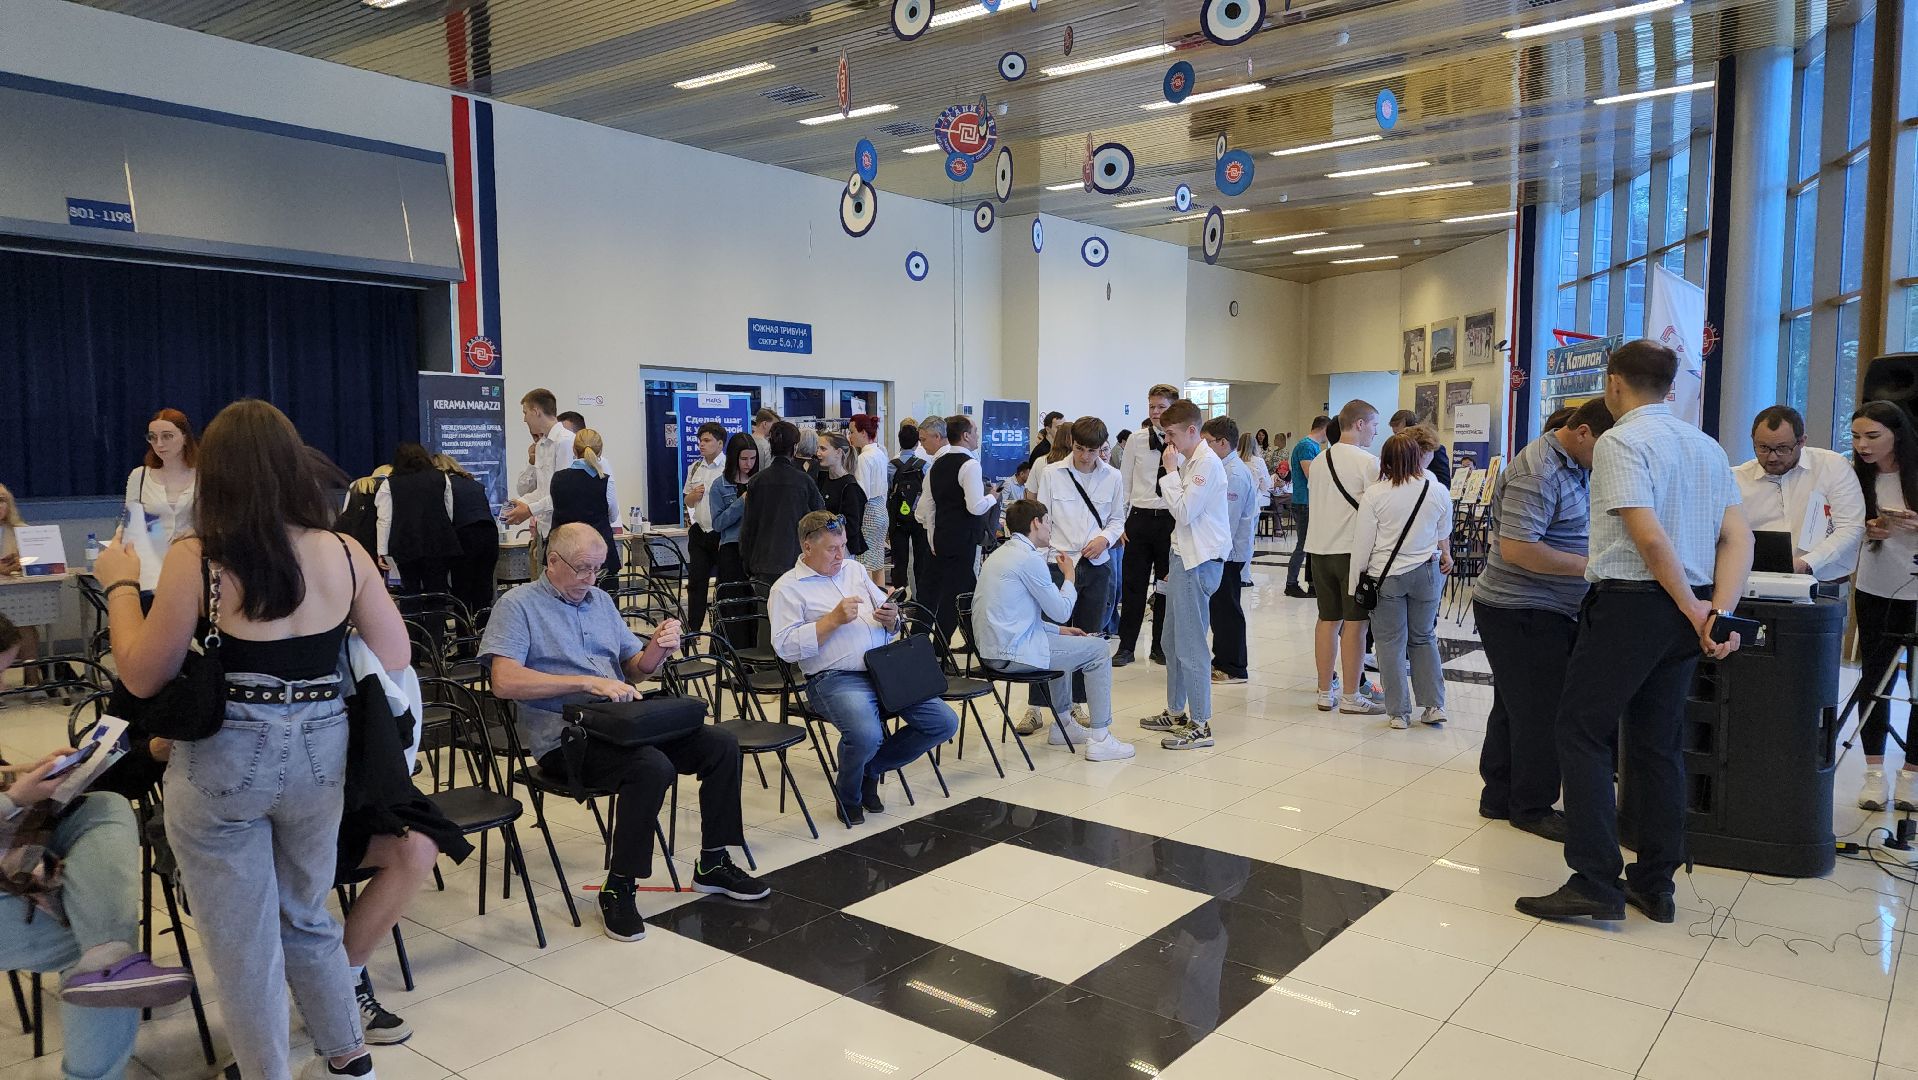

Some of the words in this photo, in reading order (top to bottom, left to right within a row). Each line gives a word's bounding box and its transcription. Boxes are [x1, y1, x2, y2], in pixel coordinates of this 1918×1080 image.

[69, 206, 132, 224] 801-1198
[752, 323, 779, 334] ЮЖНАЯ
[780, 326, 808, 337] ТРИБУНА
[433, 399, 466, 410] KERAMA
[466, 400, 501, 411] MARAZZI
[685, 414, 722, 425] Сделай
[723, 416, 743, 425] шаг
